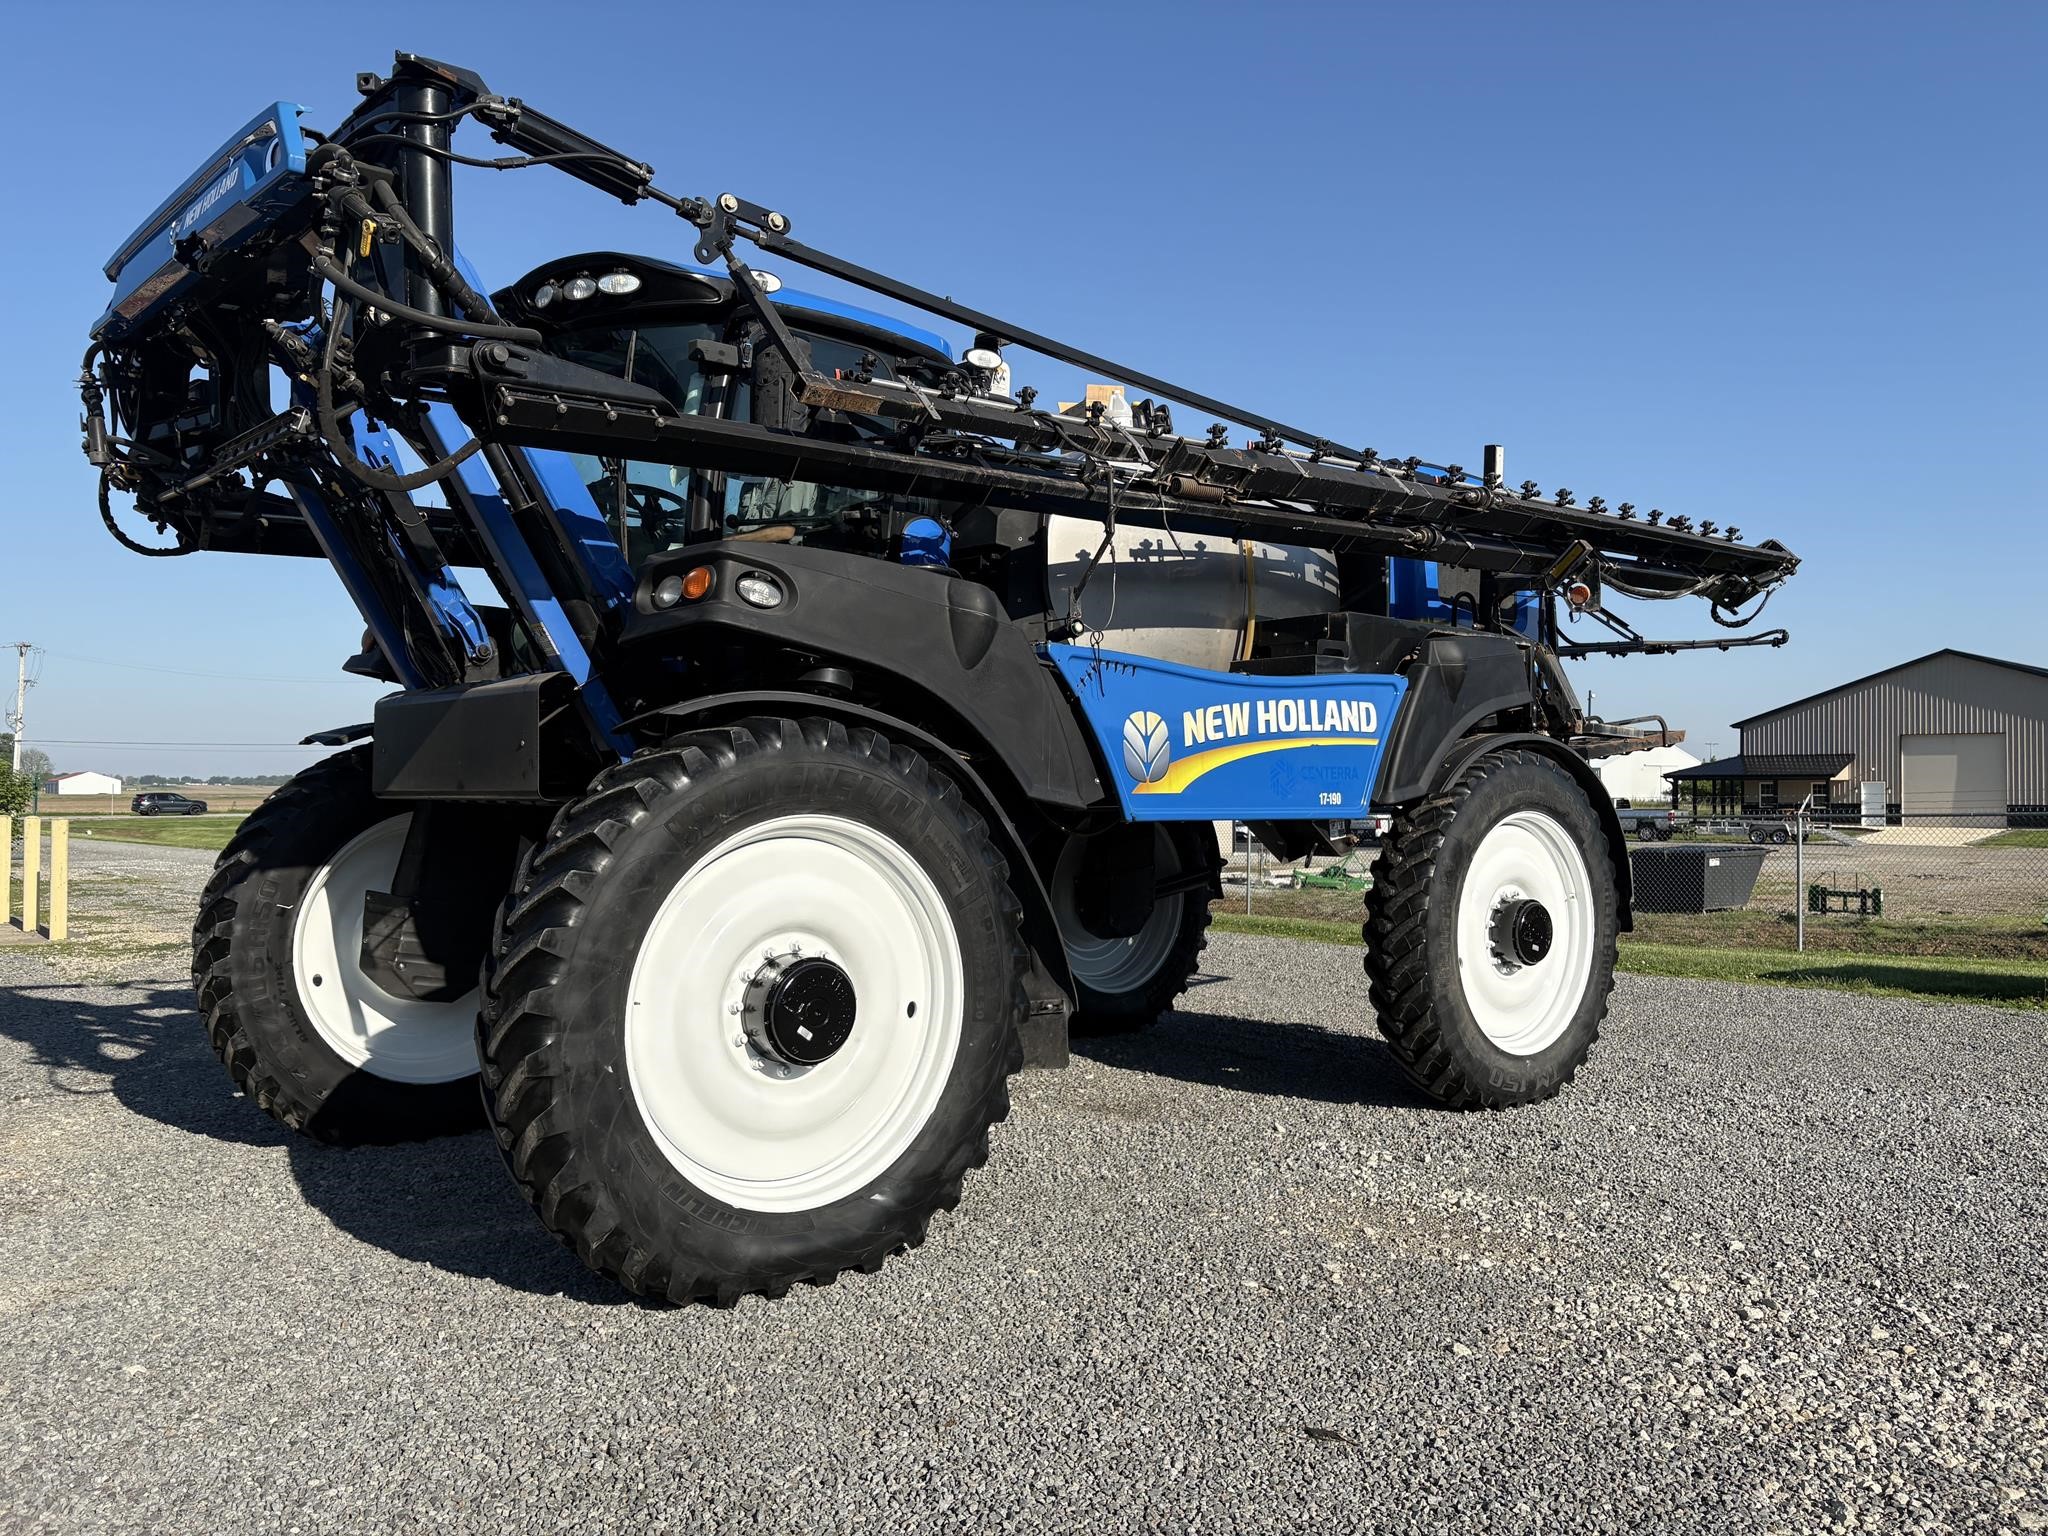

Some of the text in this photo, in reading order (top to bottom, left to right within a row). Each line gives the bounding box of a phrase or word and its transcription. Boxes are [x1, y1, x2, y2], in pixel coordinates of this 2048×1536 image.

[184, 167, 239, 230] NEW HOLLAND
[1183, 699, 1378, 748] NEW HOLLAND
[1301, 765, 1360, 781] CENTERRA
[1319, 792, 1342, 805] 17-190
[1488, 1066, 1527, 1092] 150
